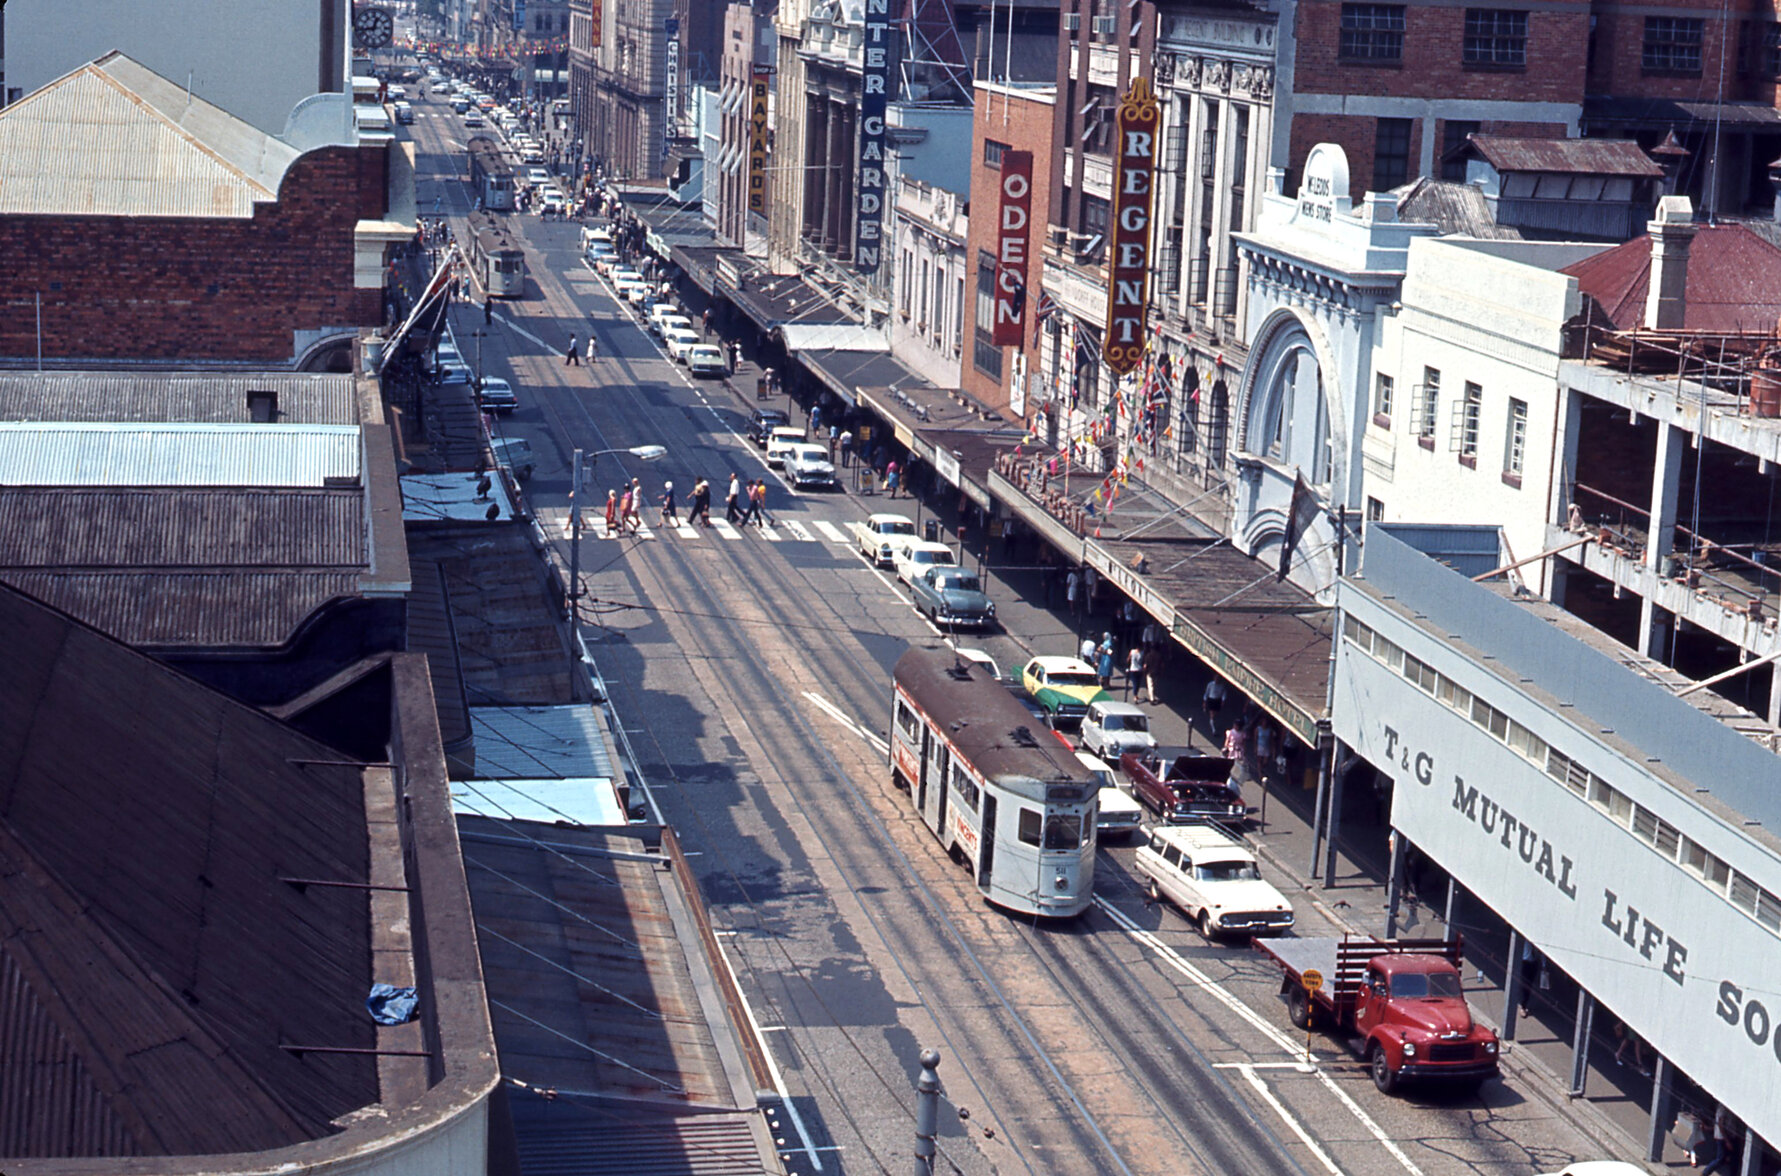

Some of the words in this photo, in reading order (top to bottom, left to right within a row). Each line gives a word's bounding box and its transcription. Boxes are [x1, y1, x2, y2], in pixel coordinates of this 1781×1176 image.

[667, 43, 678, 137] CHRISTIES
[750, 83, 766, 208] BAYARDS
[858, 116, 885, 266] GARDEN
[997, 173, 1028, 325] ODEON
[1113, 130, 1152, 343] REGENT
[1316, 204, 1332, 223] STORE
[1179, 624, 1220, 663] BRITISH
[1224, 656, 1265, 698] EMPIRE
[1268, 693, 1310, 736] HOTEL
[1452, 775, 1578, 901] MUTUAL
[1602, 888, 1689, 987] LIFE
